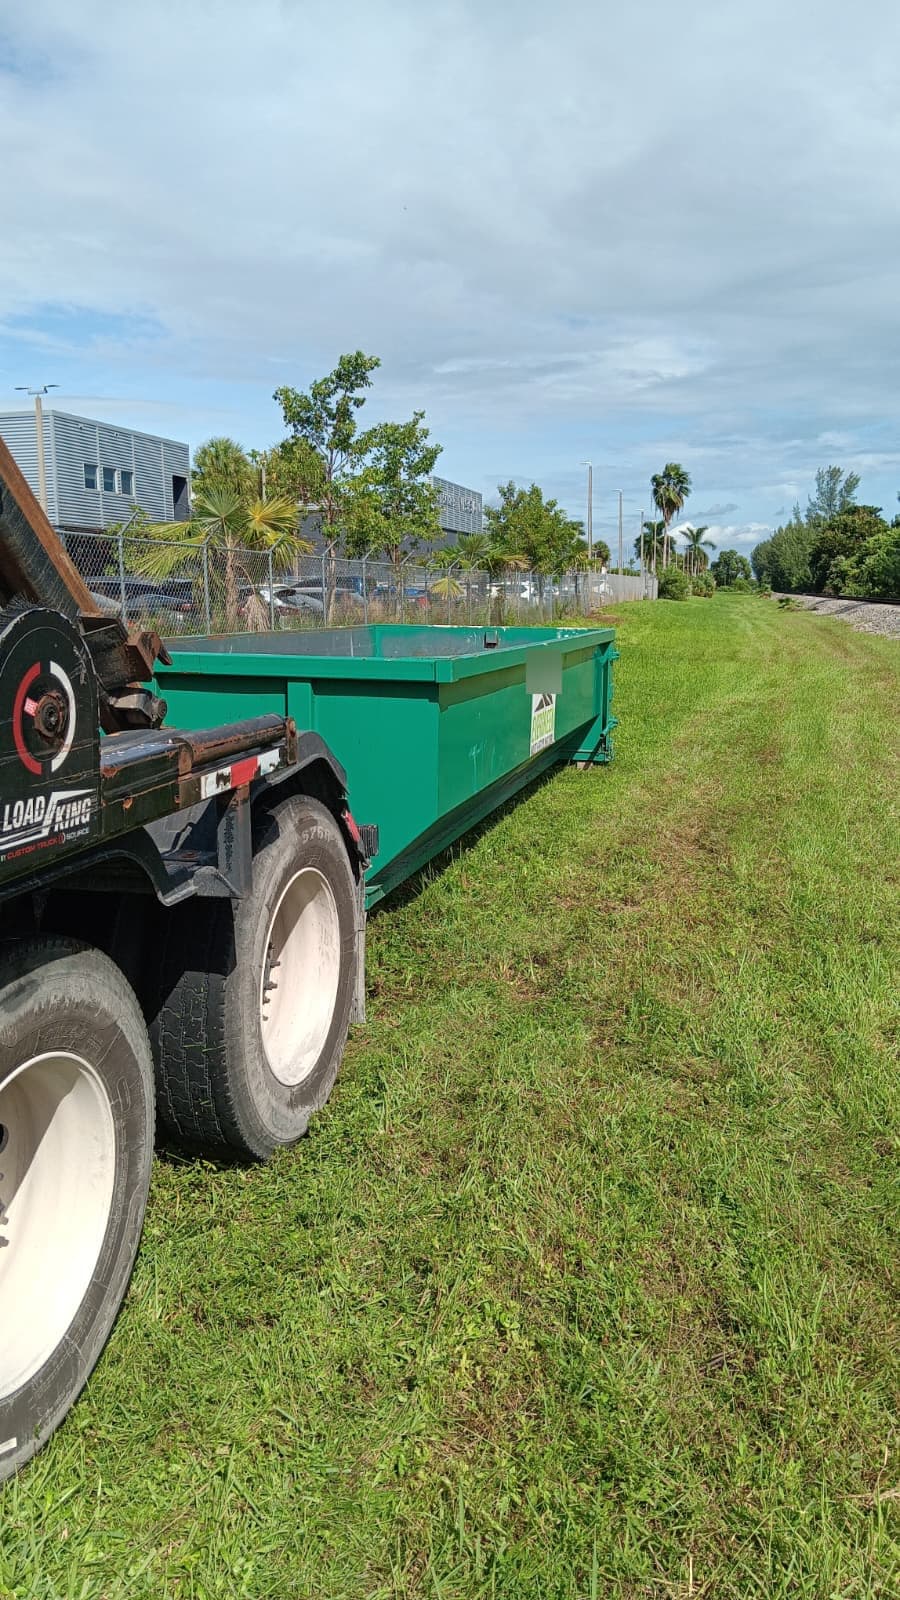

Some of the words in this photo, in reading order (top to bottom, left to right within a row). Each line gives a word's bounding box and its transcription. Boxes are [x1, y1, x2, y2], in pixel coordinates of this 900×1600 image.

[3, 795, 46, 832] LOAD
[54, 797, 91, 832] KING
[7, 845, 36, 859] CUSTOM
